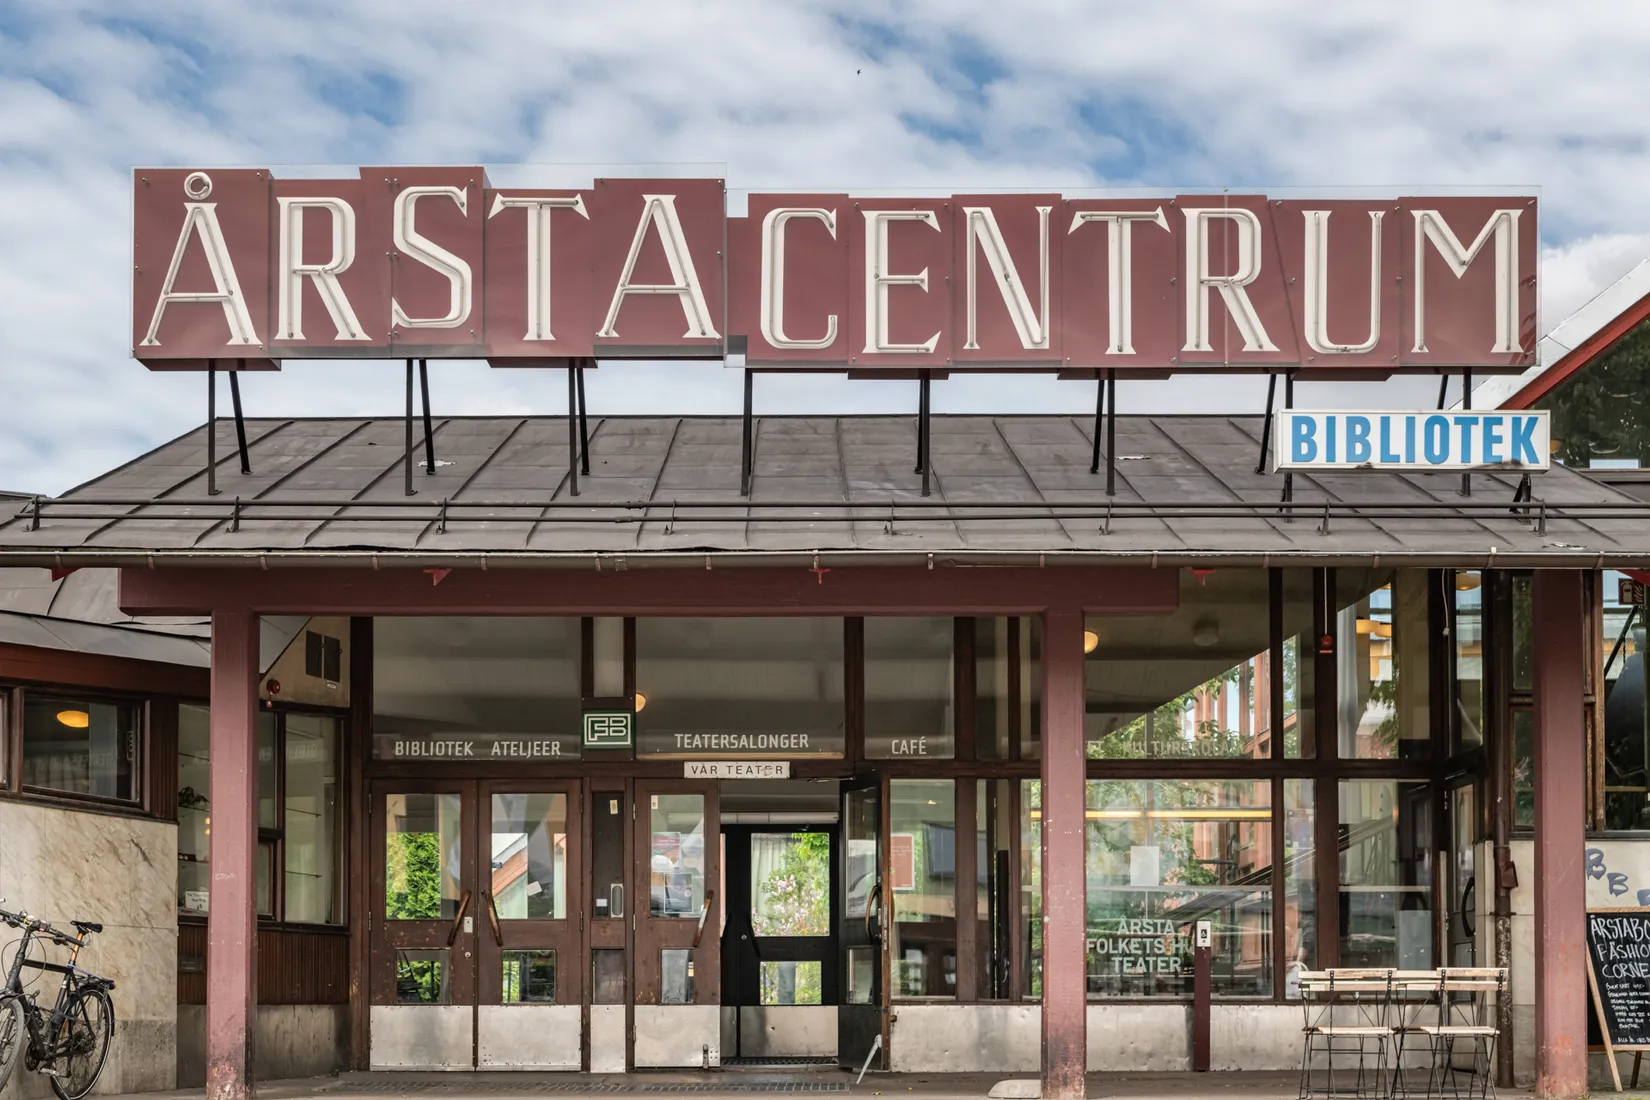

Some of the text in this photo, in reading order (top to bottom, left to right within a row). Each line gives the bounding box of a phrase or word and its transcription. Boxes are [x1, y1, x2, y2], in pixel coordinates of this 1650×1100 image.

[139, 170, 1525, 355] ÅRSTA CENTRUM
[1291, 413, 1541, 465] BIBLIOTEK
[394, 740, 561, 758] BIBLIOTEK ATELJEER
[674, 733, 810, 749] TEATERSALONGER
[891, 735, 928, 755] CAFÉ
[691, 763, 783, 776] VÅR TEATER
[1117, 916, 1176, 935] ÅRSTA
[1086, 938, 1196, 954] FOLKETS HU
[1111, 957, 1182, 973] TEATER
